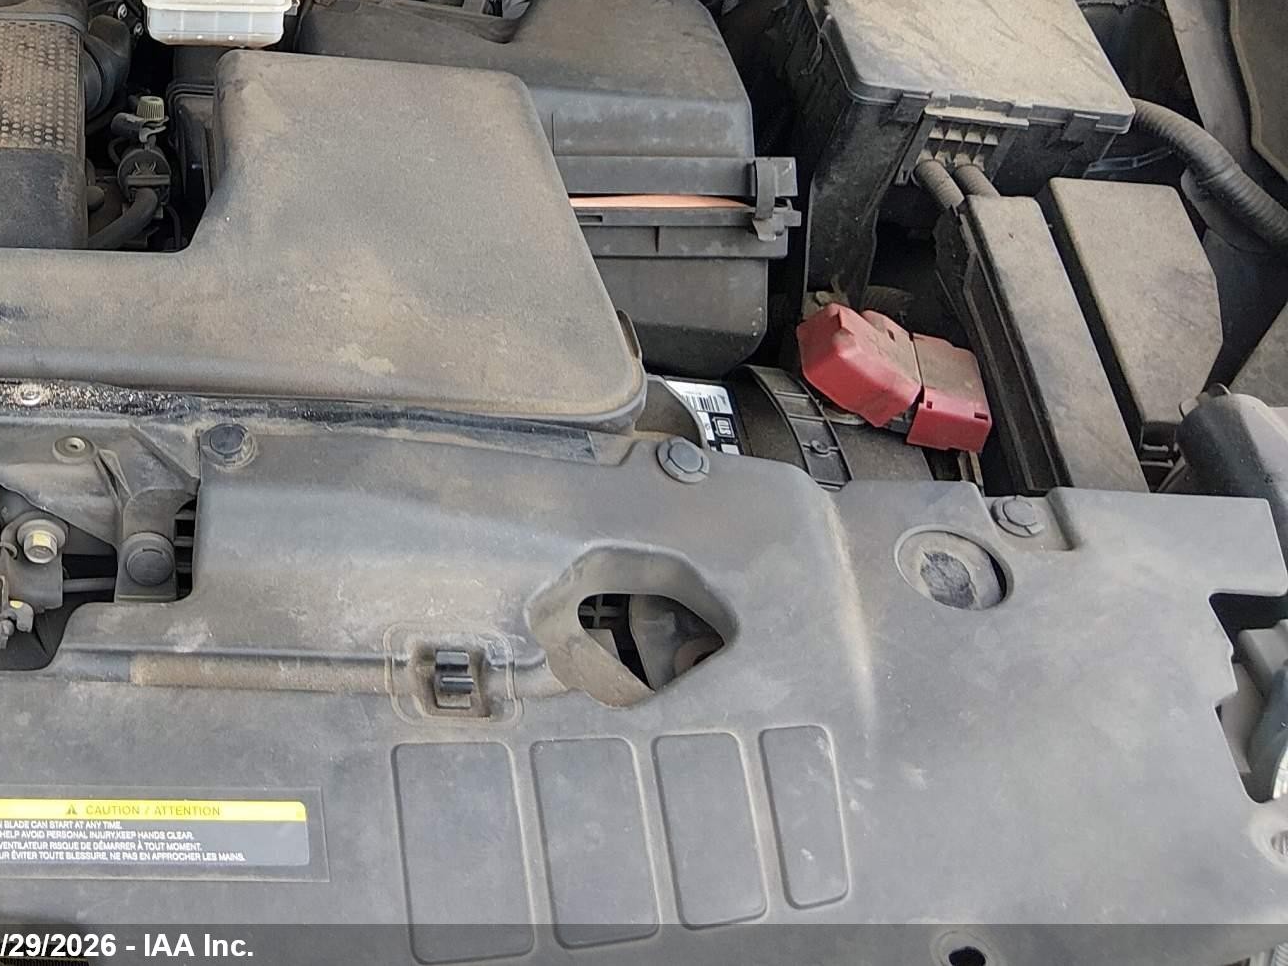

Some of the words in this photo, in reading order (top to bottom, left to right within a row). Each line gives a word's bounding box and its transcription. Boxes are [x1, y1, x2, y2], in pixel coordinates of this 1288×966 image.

[86, 805, 140, 816] CAUTION
[154, 806, 221, 816] ATTENTION
[4, 820, 30, 829] BLADE
[30, 820, 48, 829] CAN
[49, 820, 74, 829] START
[74, 821, 85, 829] AT
[86, 821, 103, 829] ANY
[0, 830, 21, 839] HELP
[21, 830, 45, 839] AVOID
[46, 830, 88, 839] PERSONAL
[138, 832, 166, 840] HANDS
[166, 832, 194, 840] CLEAR.
[50, 842, 80, 851] RISQUE
[80, 842, 92, 850] DE
[92, 840, 136, 850] DÉMARRER
[144, 842, 166, 851] TOUT
[166, 842, 202, 851] MOMENT.
[12, 850, 38, 860] ÉVITER
[38, 852, 64, 860] TOUTE
[110, 852, 121, 860] NE
[122, 852, 138, 860] PAS
[139, 852, 150, 860] EN
[152, 852, 201, 861] APPROCHER
[202, 853, 218, 861] LES
